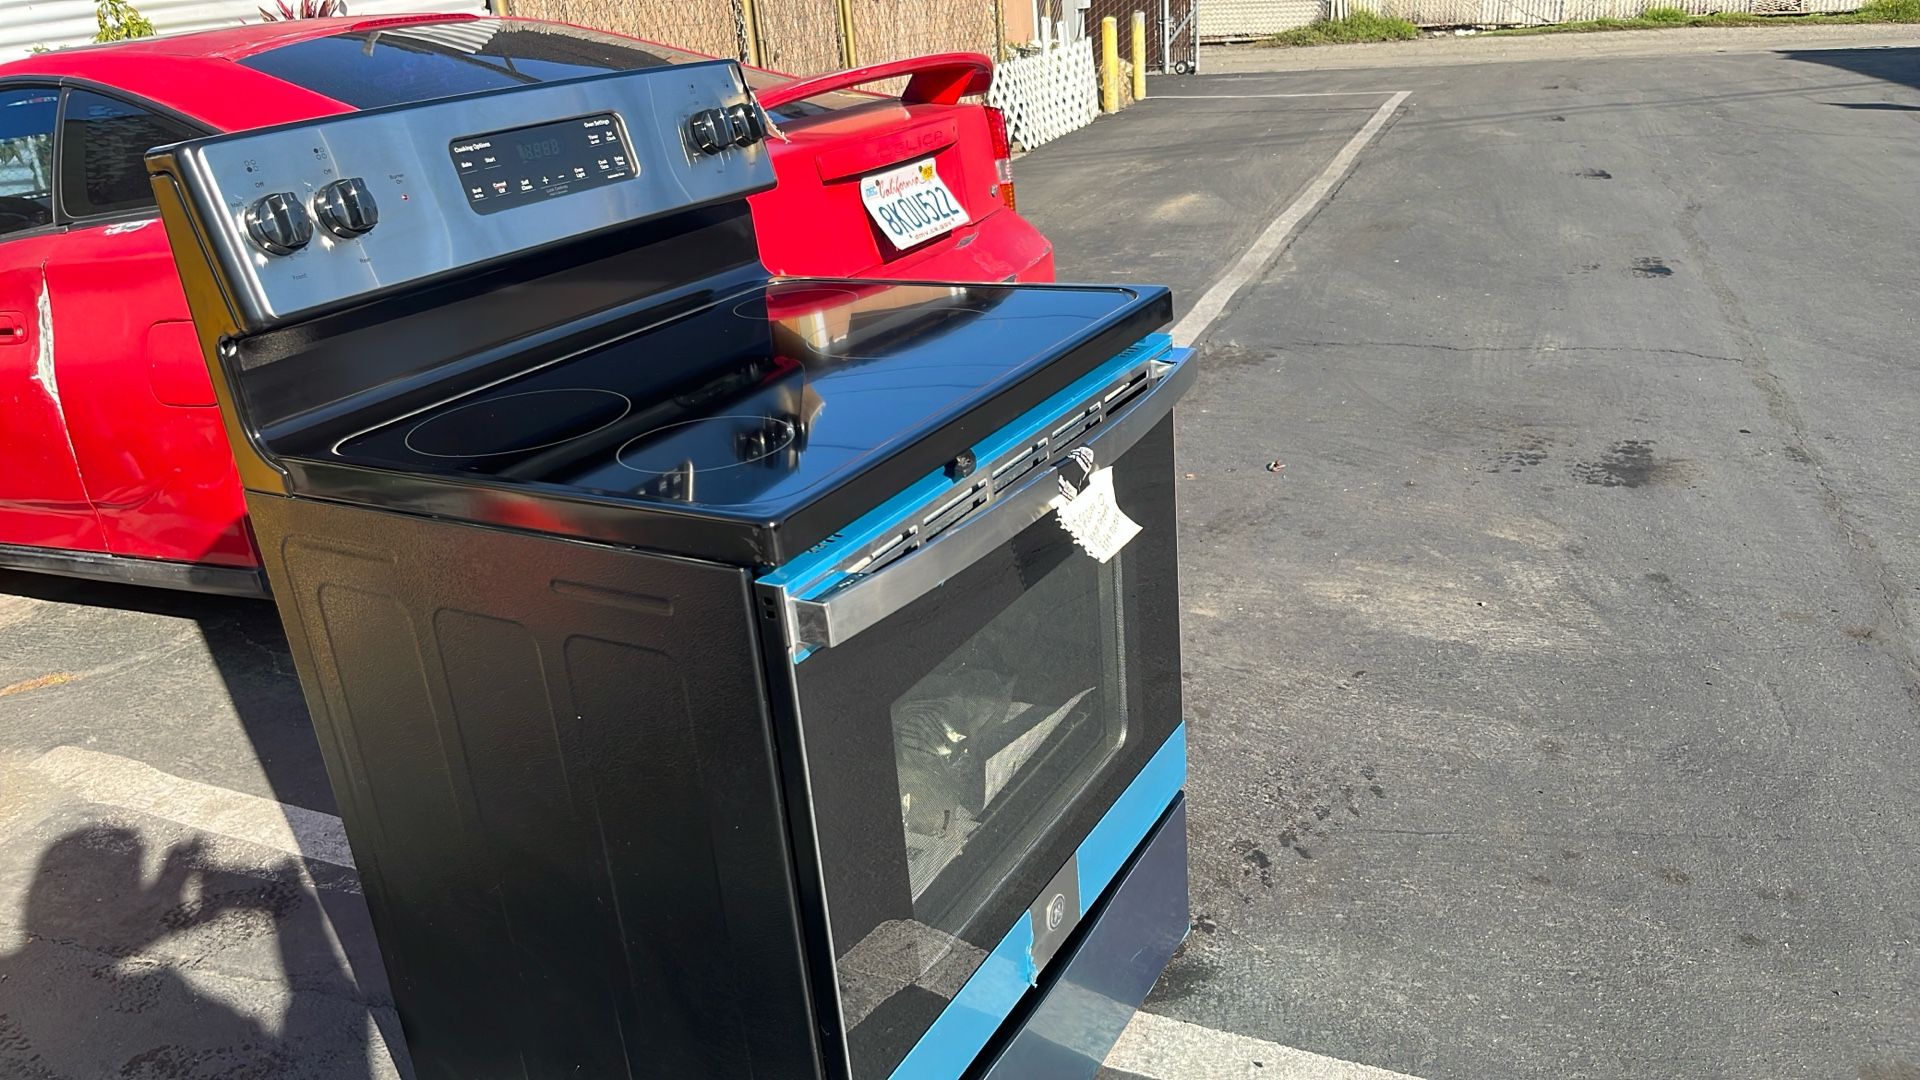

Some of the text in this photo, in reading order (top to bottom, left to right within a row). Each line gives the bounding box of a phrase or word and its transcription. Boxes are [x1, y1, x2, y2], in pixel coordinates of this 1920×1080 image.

[453, 142, 491, 154] Cooking Options
[878, 173, 921, 199] California
